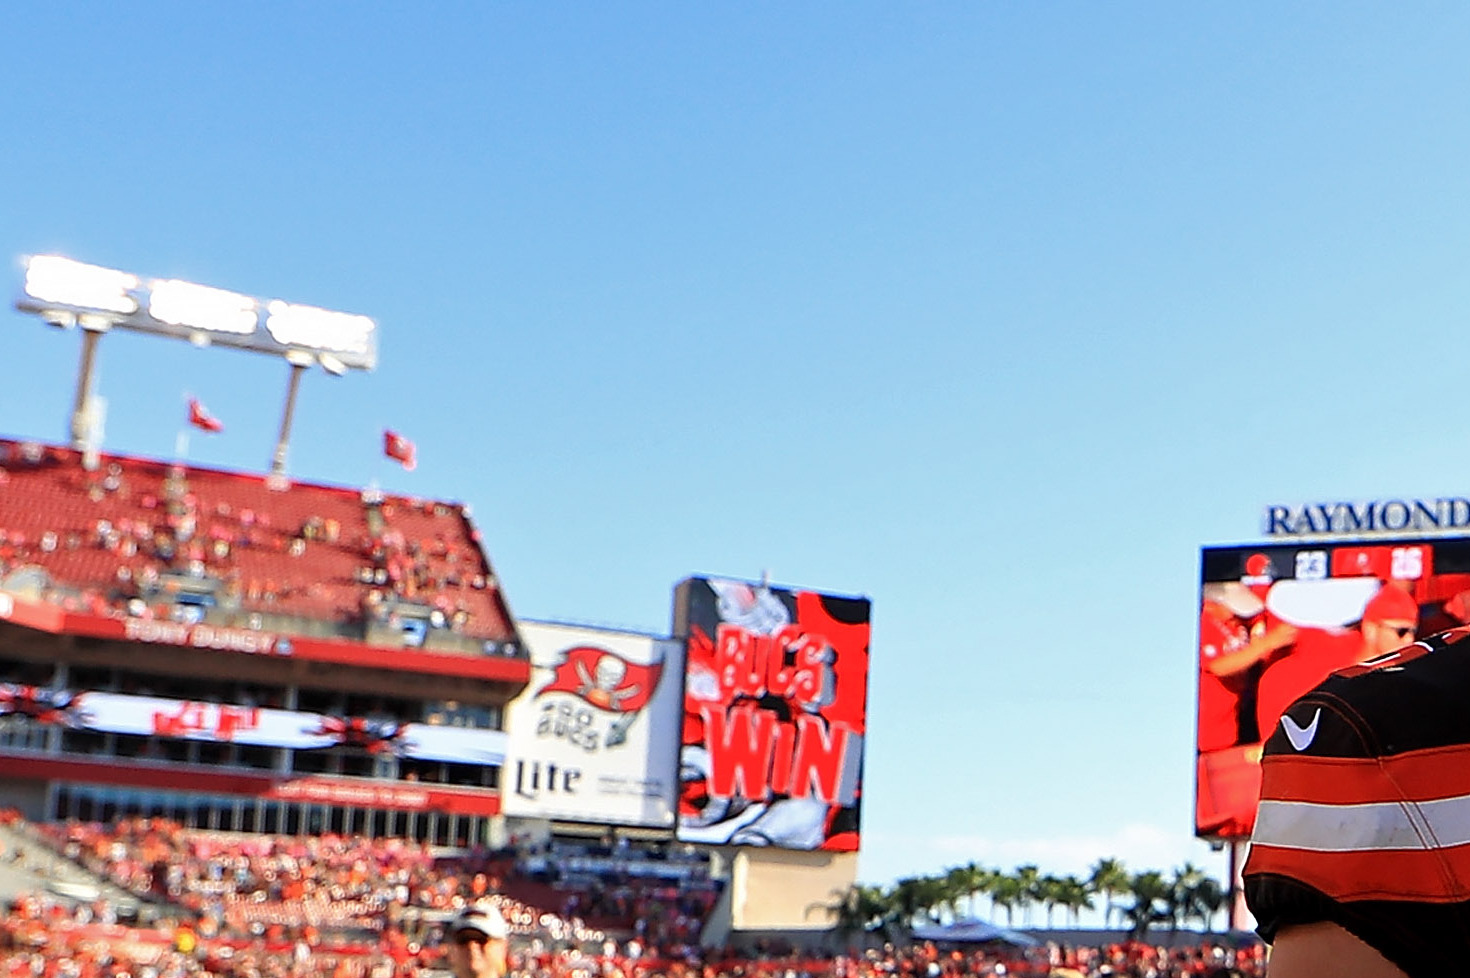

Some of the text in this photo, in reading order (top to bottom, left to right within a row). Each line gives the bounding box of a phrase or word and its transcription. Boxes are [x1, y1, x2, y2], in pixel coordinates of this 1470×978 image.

[716, 623, 828, 706] BUCS
[515, 760, 582, 799] Lite
[701, 704, 852, 803] WIN
